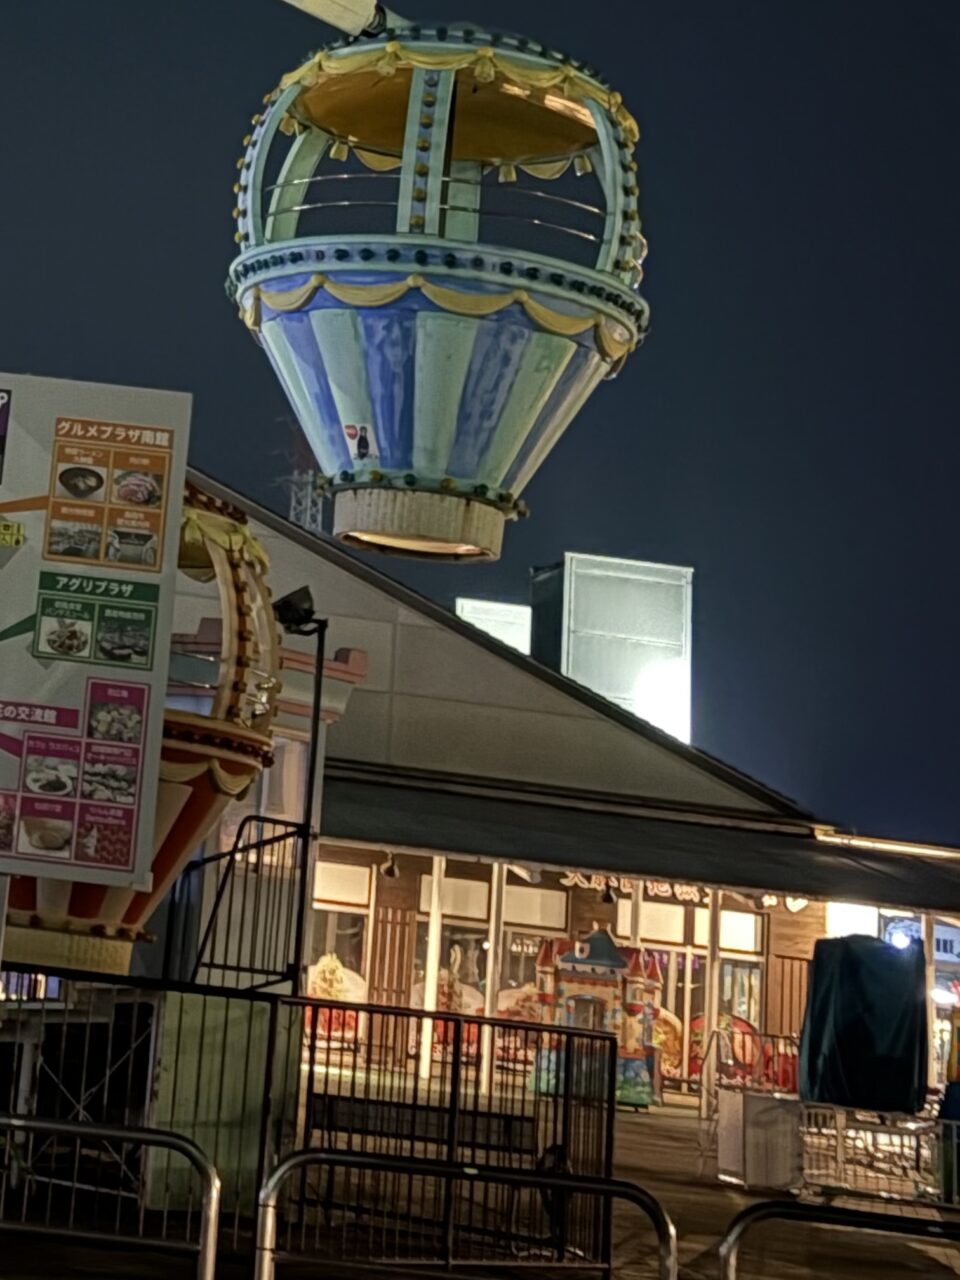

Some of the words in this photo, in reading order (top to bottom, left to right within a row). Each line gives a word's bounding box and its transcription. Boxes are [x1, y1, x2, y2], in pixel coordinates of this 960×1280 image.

[57, 421, 170, 446] グルメプラザ南館
[55, 576, 134, 597] アグリプラザ
